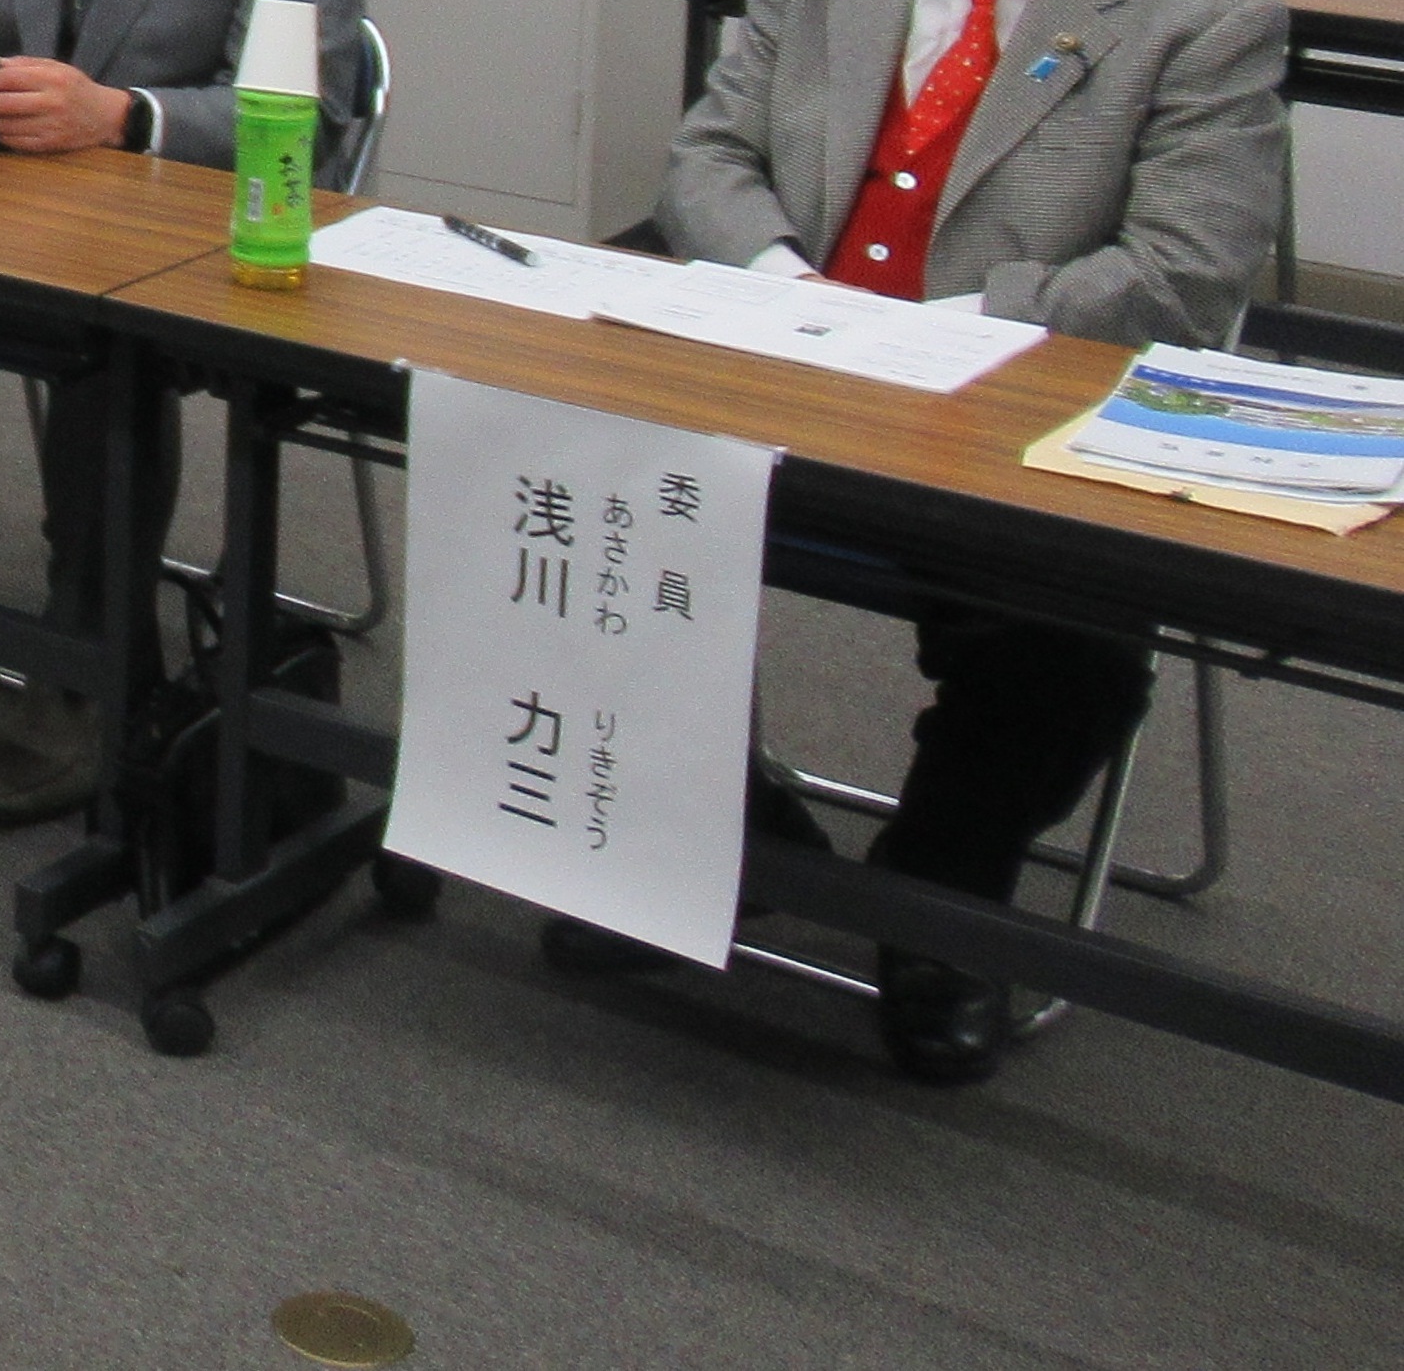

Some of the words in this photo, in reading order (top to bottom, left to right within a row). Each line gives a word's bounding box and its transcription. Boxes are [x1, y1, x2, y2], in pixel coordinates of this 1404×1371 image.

[510, 475, 575, 619] 浅川
[594, 494, 634, 635] あさかわ
[653, 471, 699, 622] 委員
[498, 691, 561, 828] 力三
[586, 709, 618, 851] りきぞう
